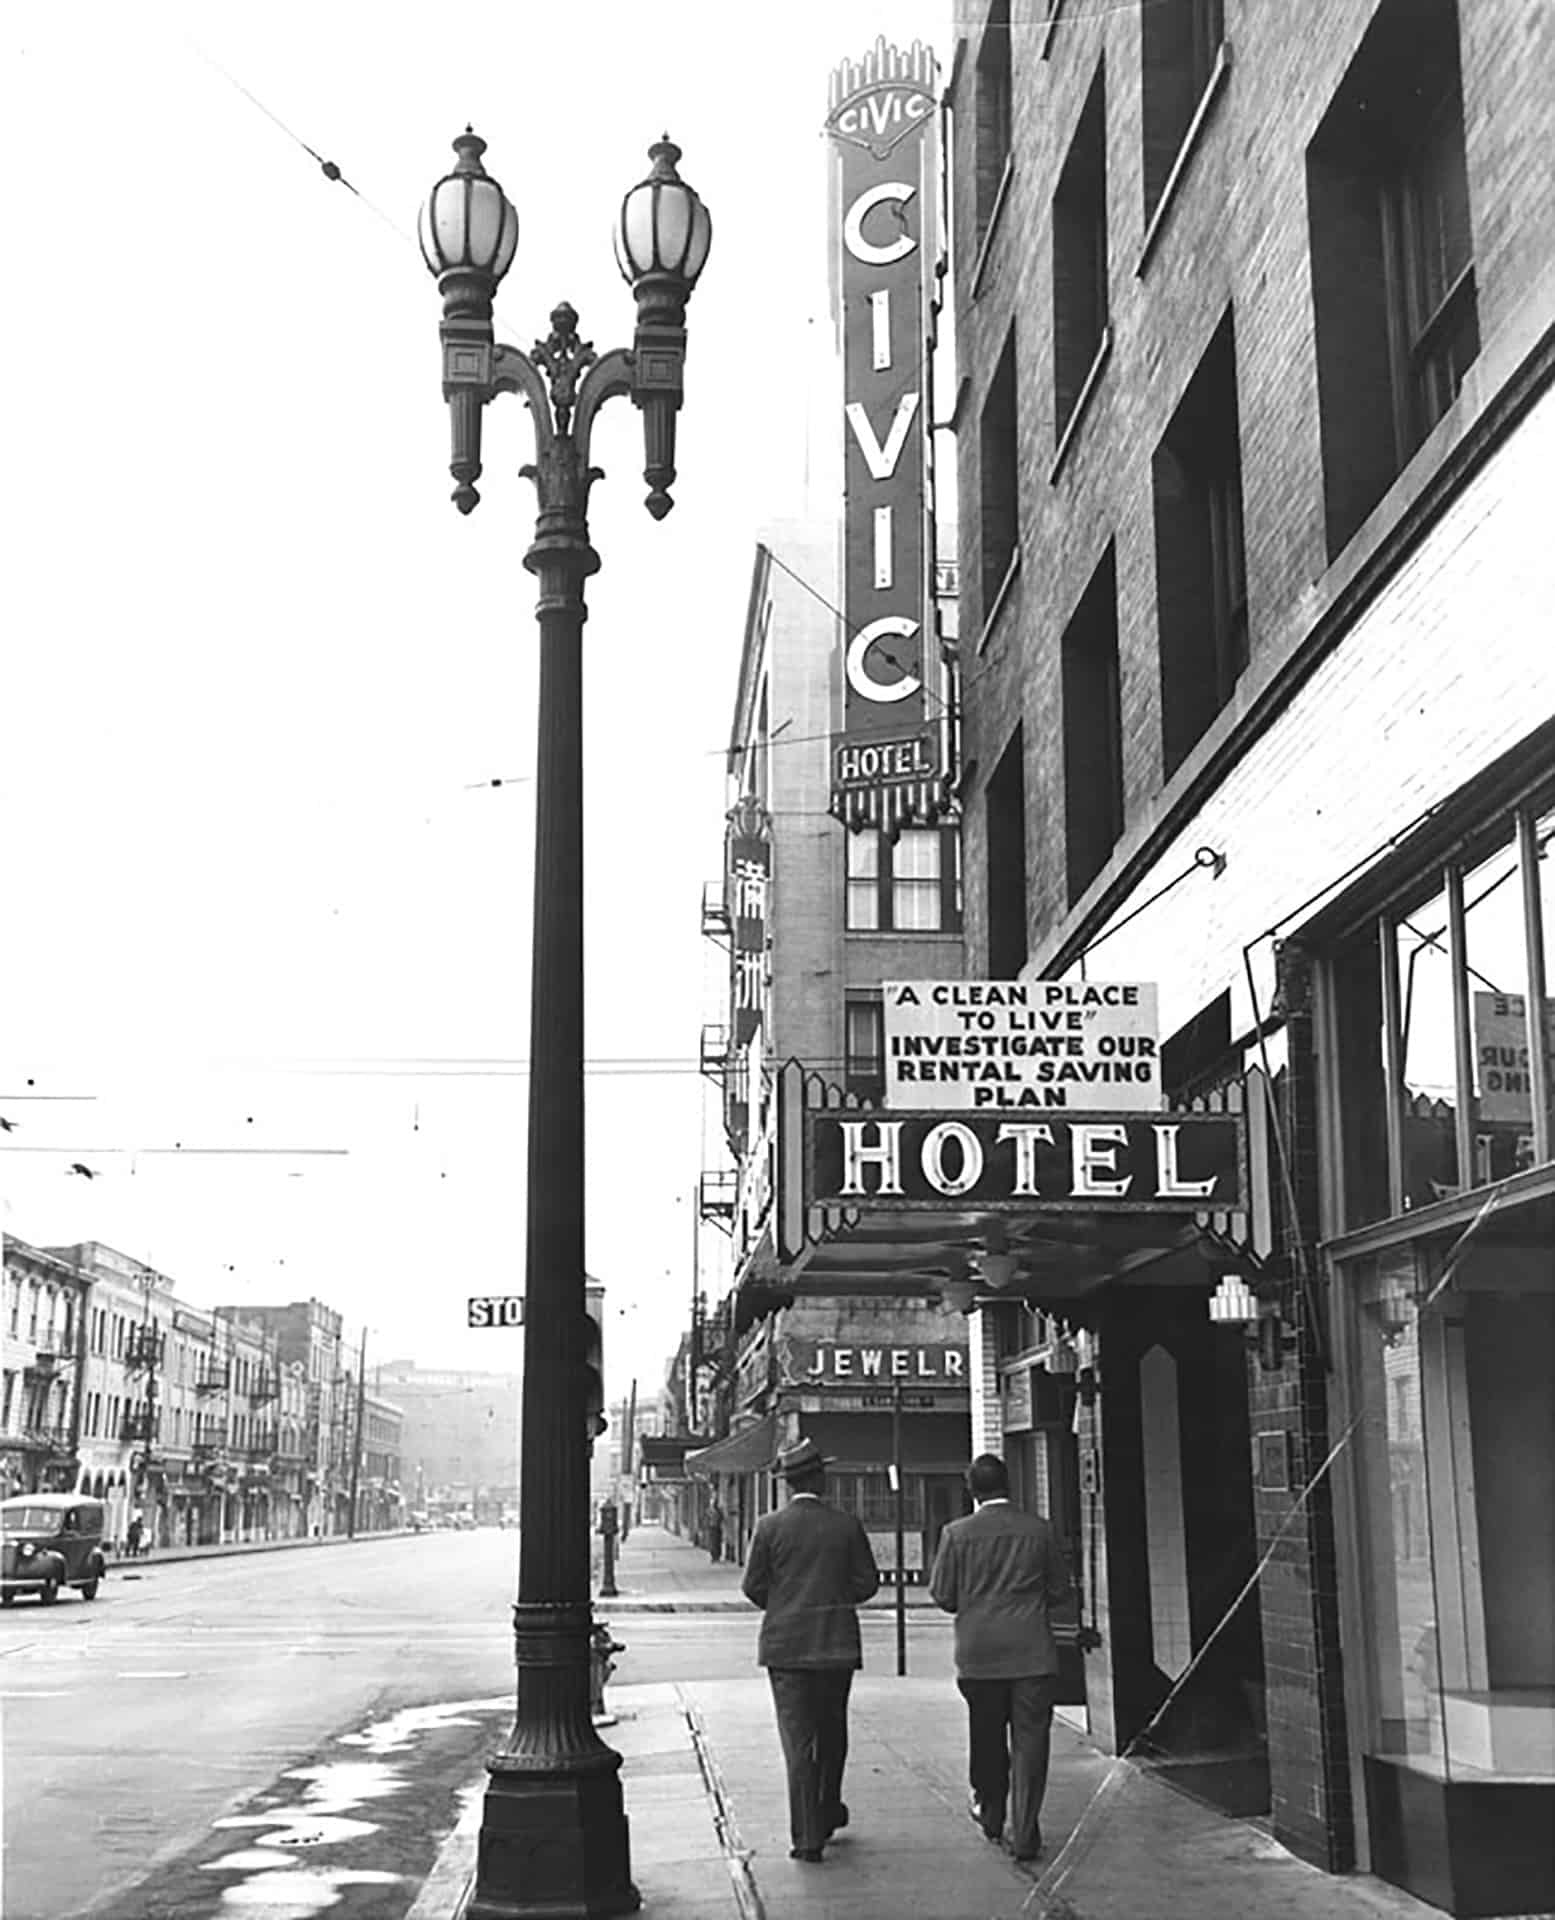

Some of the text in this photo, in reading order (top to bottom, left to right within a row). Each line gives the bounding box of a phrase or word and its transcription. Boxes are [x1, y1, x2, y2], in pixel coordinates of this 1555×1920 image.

[839, 93, 924, 133] CIVIC
[843, 181, 919, 702] CIVIC
[841, 742, 930, 778] HOTEL
[932, 986, 1028, 1005] CLEAN
[1046, 986, 1139, 1005] PLACE
[957, 1011, 996, 1030] TO
[891, 1036, 1158, 1057] INVESTIGATE OUR
[897, 1061, 1152, 1082] RENTAL SAVING
[974, 1087, 1067, 1107] PLAN
[839, 1121, 1218, 1197] HOTEL
[470, 1298, 524, 1326] STO
[807, 1349, 964, 1377] JEWELR
